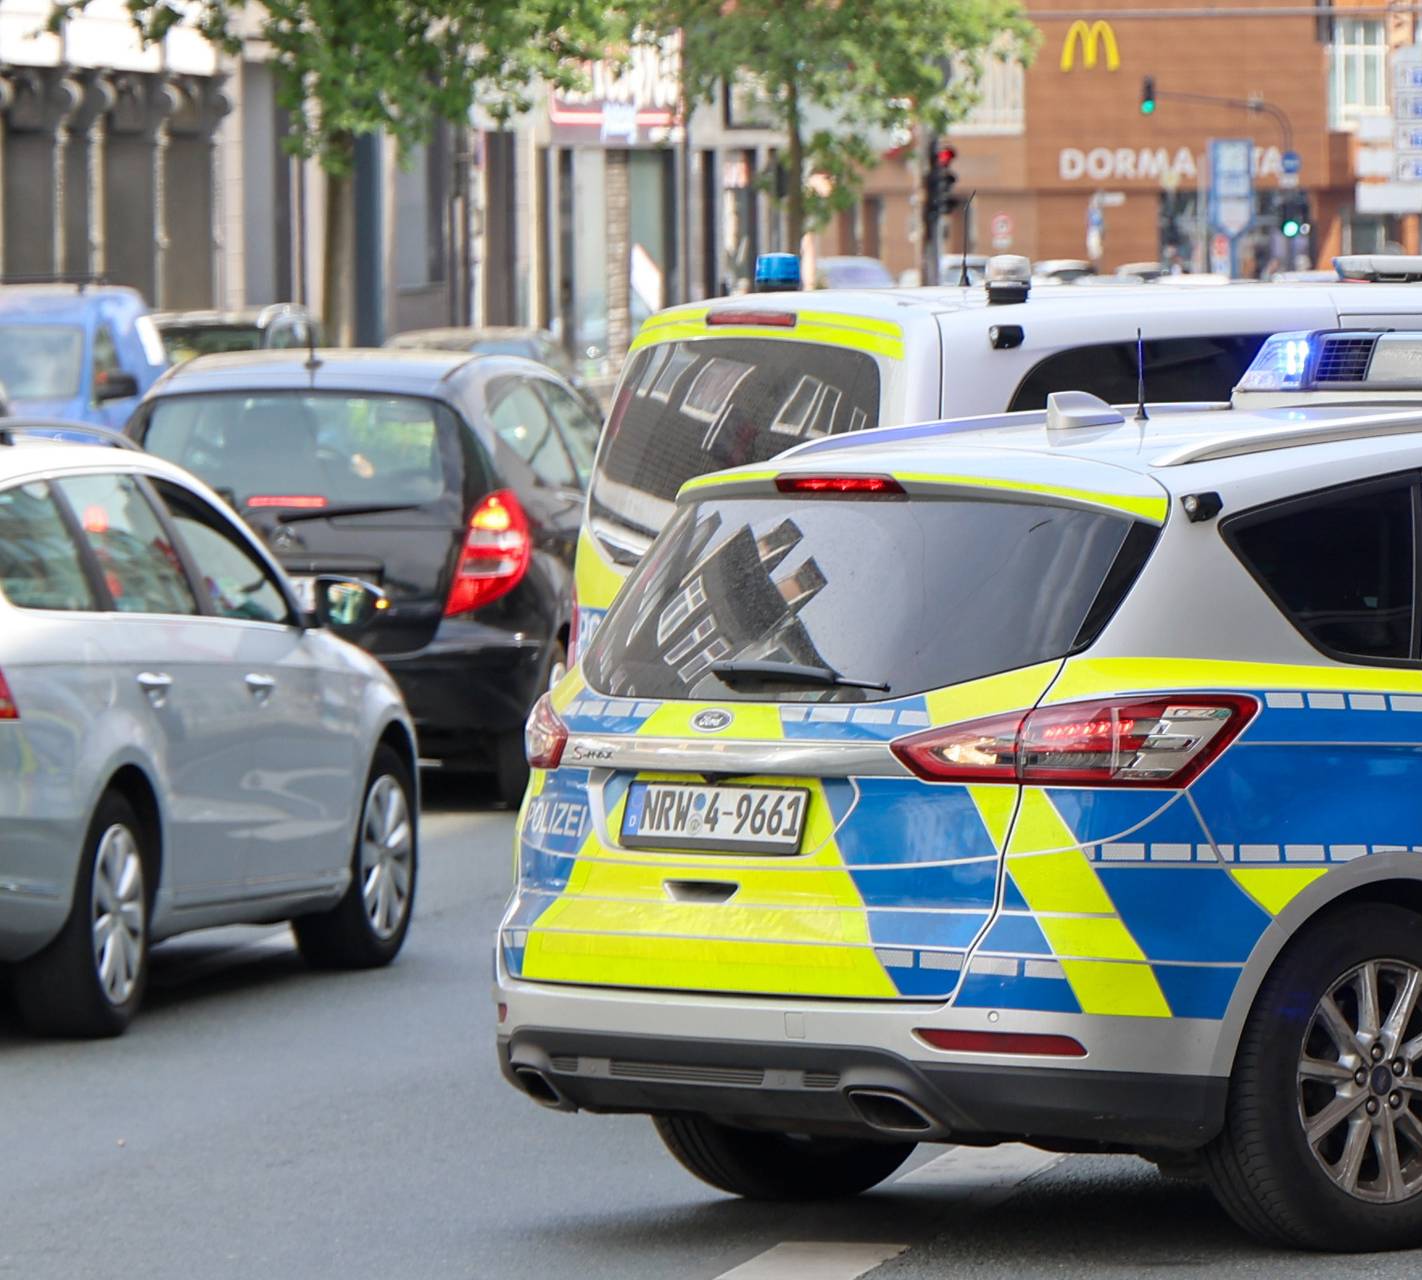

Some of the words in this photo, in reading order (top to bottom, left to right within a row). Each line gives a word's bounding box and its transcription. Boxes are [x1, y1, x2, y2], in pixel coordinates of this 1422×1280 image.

[1059, 146, 1198, 181] DORMA
[698, 711, 724, 727] Ford
[526, 800, 587, 838] POLIZEI
[628, 815, 636, 828] D
[639, 789, 694, 832] NRW
[702, 792, 801, 837] 4-9661
